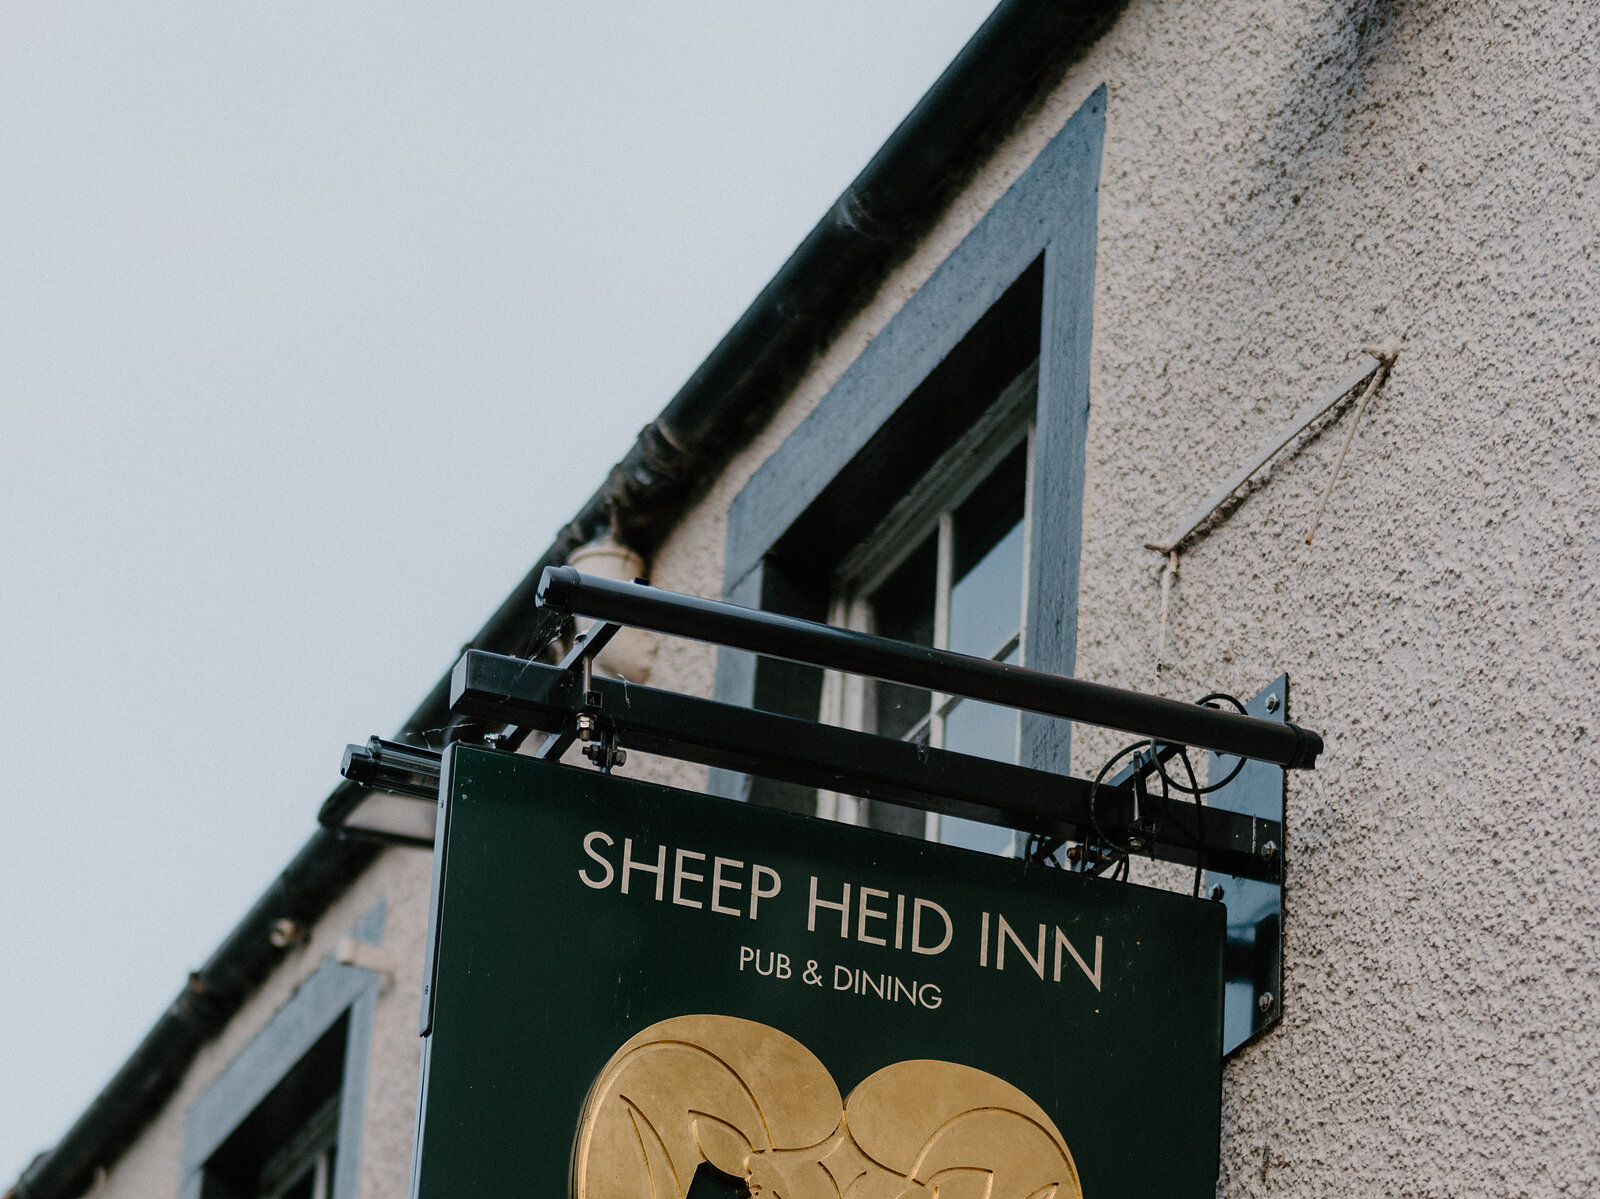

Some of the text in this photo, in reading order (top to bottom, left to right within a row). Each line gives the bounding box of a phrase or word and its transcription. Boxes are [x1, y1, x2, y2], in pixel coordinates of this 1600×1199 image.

[578, 830, 1103, 993] SHEEP HEID INN
[739, 945, 943, 1010] PUB & DINING
